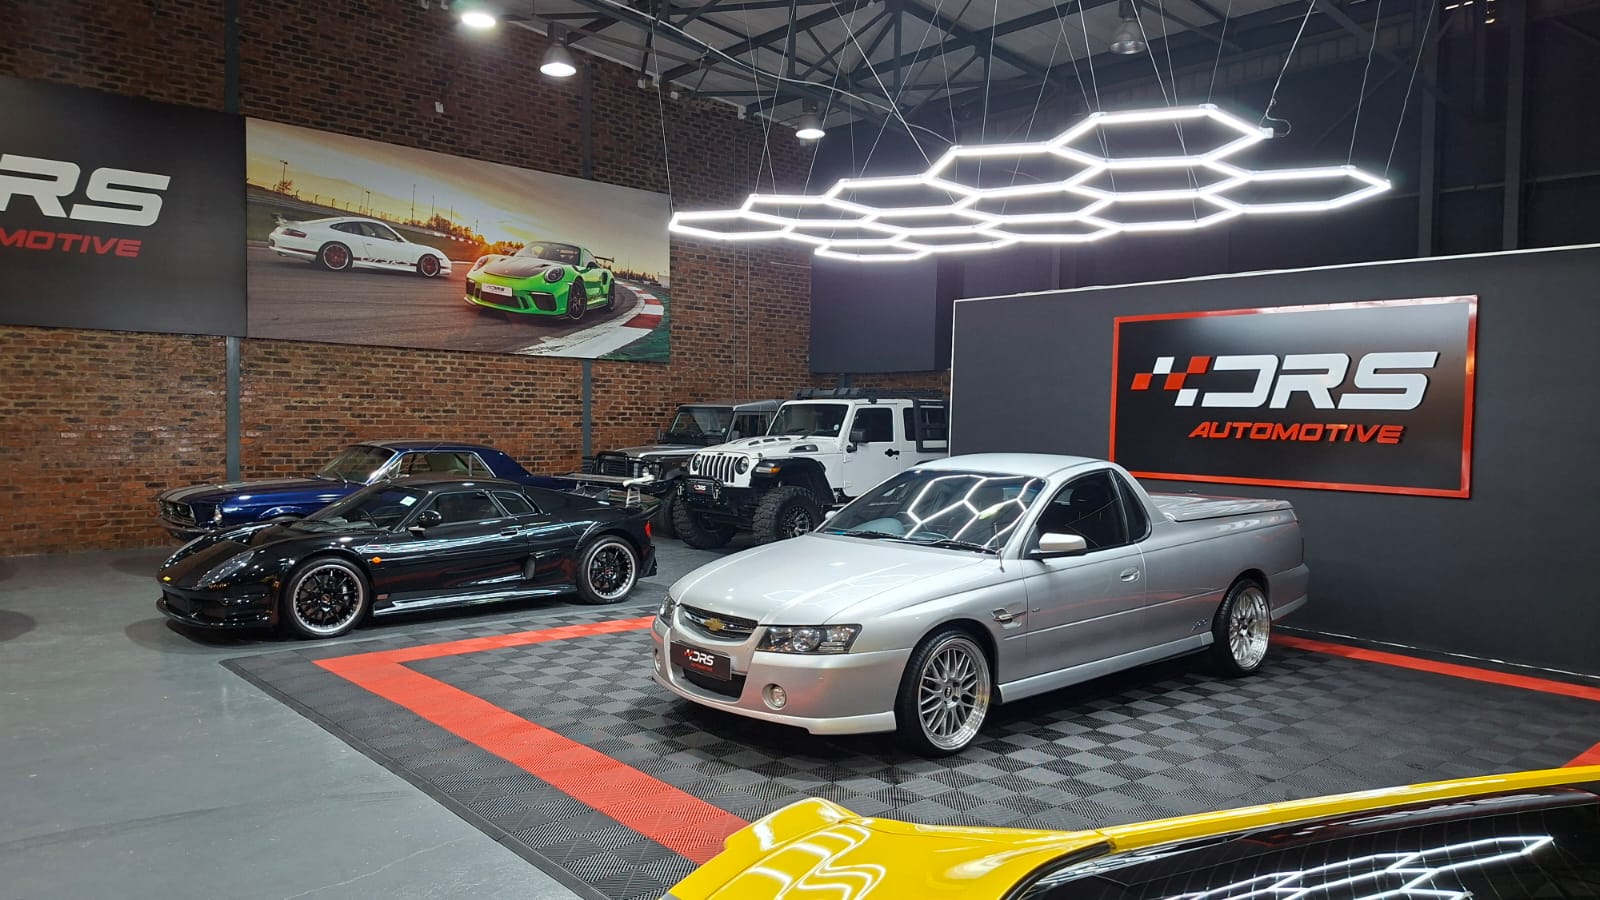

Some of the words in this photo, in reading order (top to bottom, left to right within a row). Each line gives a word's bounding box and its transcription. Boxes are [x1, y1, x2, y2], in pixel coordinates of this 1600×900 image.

[1201, 351, 1439, 410] DRS
[1188, 421, 1404, 444] AUTOMOTIVE
[692, 651, 715, 666] DRS
